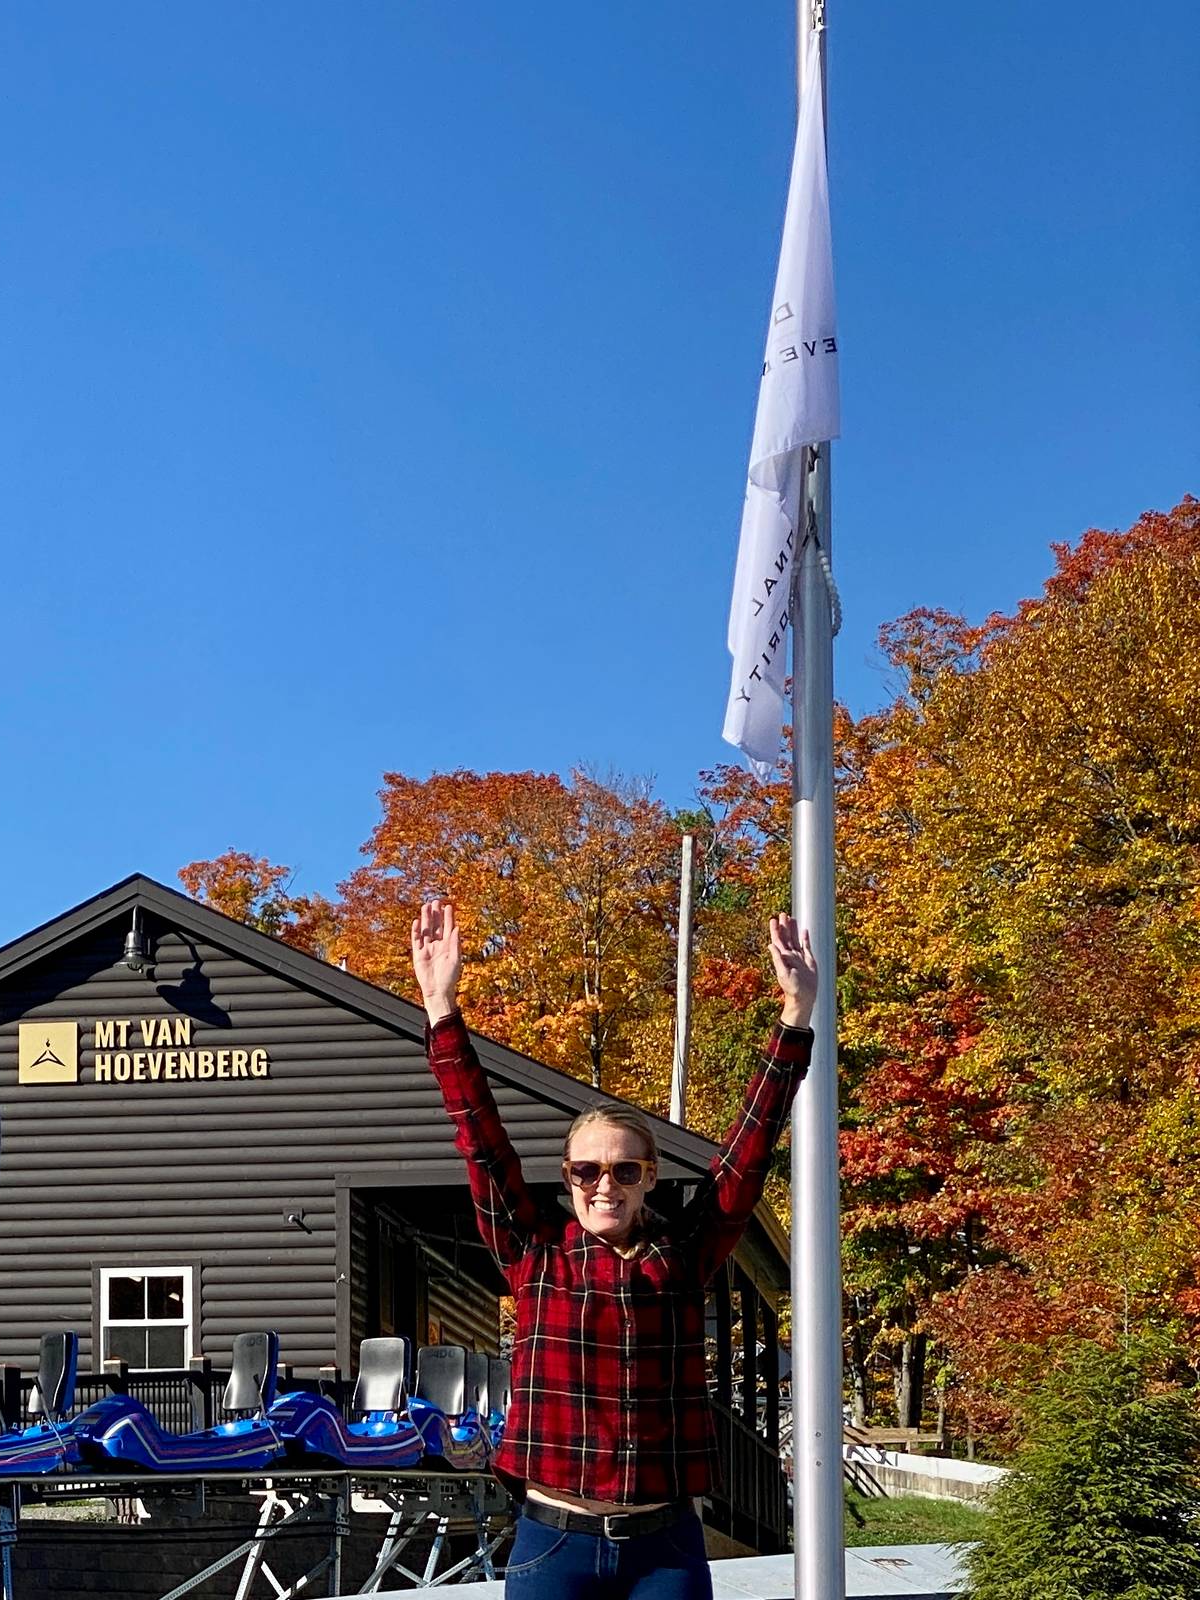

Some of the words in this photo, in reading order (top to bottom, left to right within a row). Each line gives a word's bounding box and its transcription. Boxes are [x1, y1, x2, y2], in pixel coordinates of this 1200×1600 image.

[94, 1019, 131, 1048] MT
[140, 1018, 191, 1047] VAN
[94, 1049, 269, 1081] HOEVENBERG
